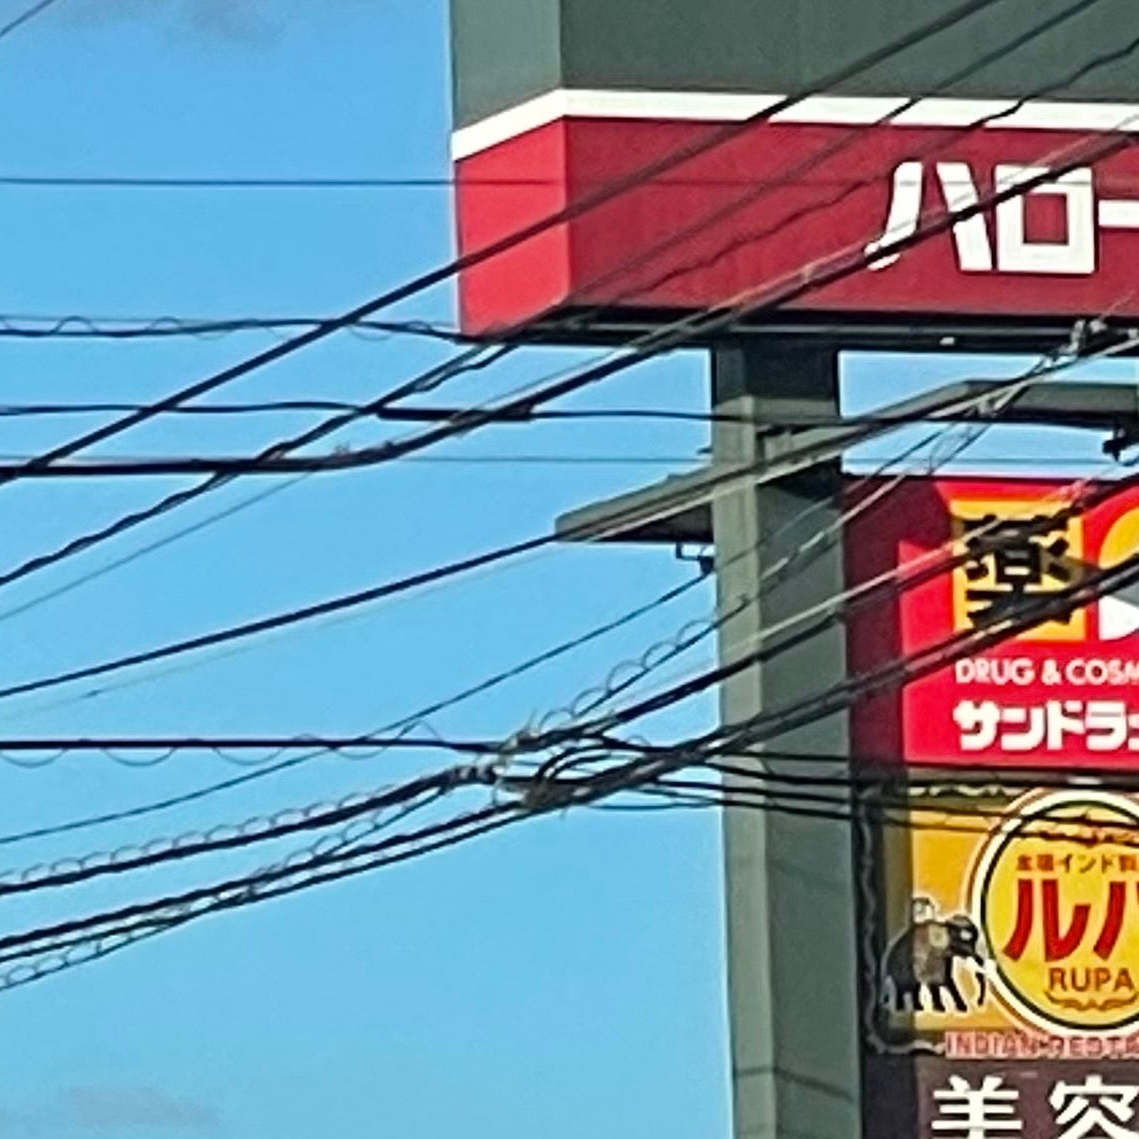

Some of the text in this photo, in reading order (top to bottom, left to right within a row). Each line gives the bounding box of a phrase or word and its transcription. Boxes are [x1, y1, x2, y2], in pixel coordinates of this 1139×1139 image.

[955, 658, 1035, 684] DRUG
[1041, 659, 1062, 686] &
[1049, 967, 1134, 992] RUPA
